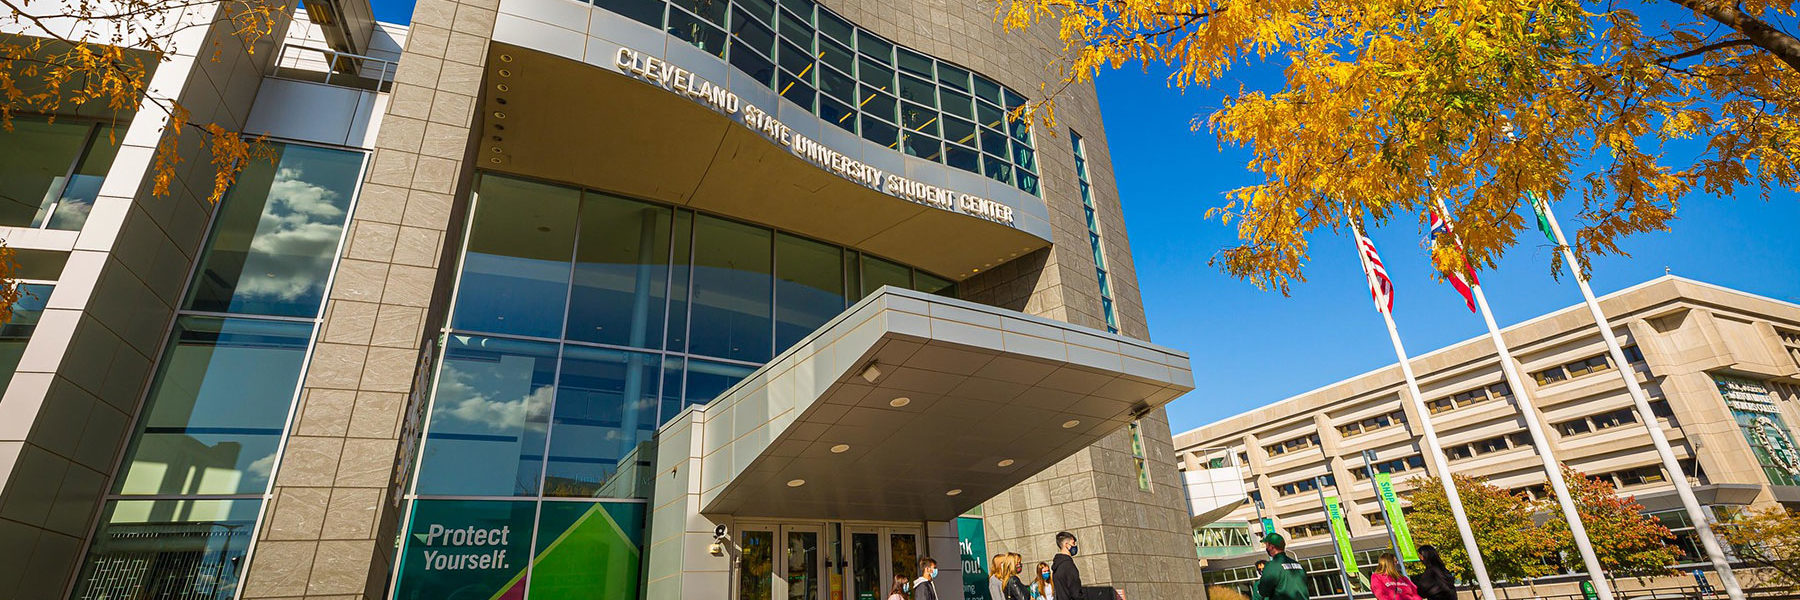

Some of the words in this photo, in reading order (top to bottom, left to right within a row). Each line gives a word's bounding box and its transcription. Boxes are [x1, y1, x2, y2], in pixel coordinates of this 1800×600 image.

[615, 47, 739, 114] CLEVELAND
[744, 104, 792, 146] STATE
[795, 133, 883, 187] UNIVERSITY
[887, 174, 955, 207] STUDENT
[959, 194, 1014, 223] CENTER
[1380, 481, 1395, 503] SHOP
[1329, 503, 1341, 520] DINE
[426, 524, 510, 546] Protect
[423, 550, 510, 570] Yourself.
